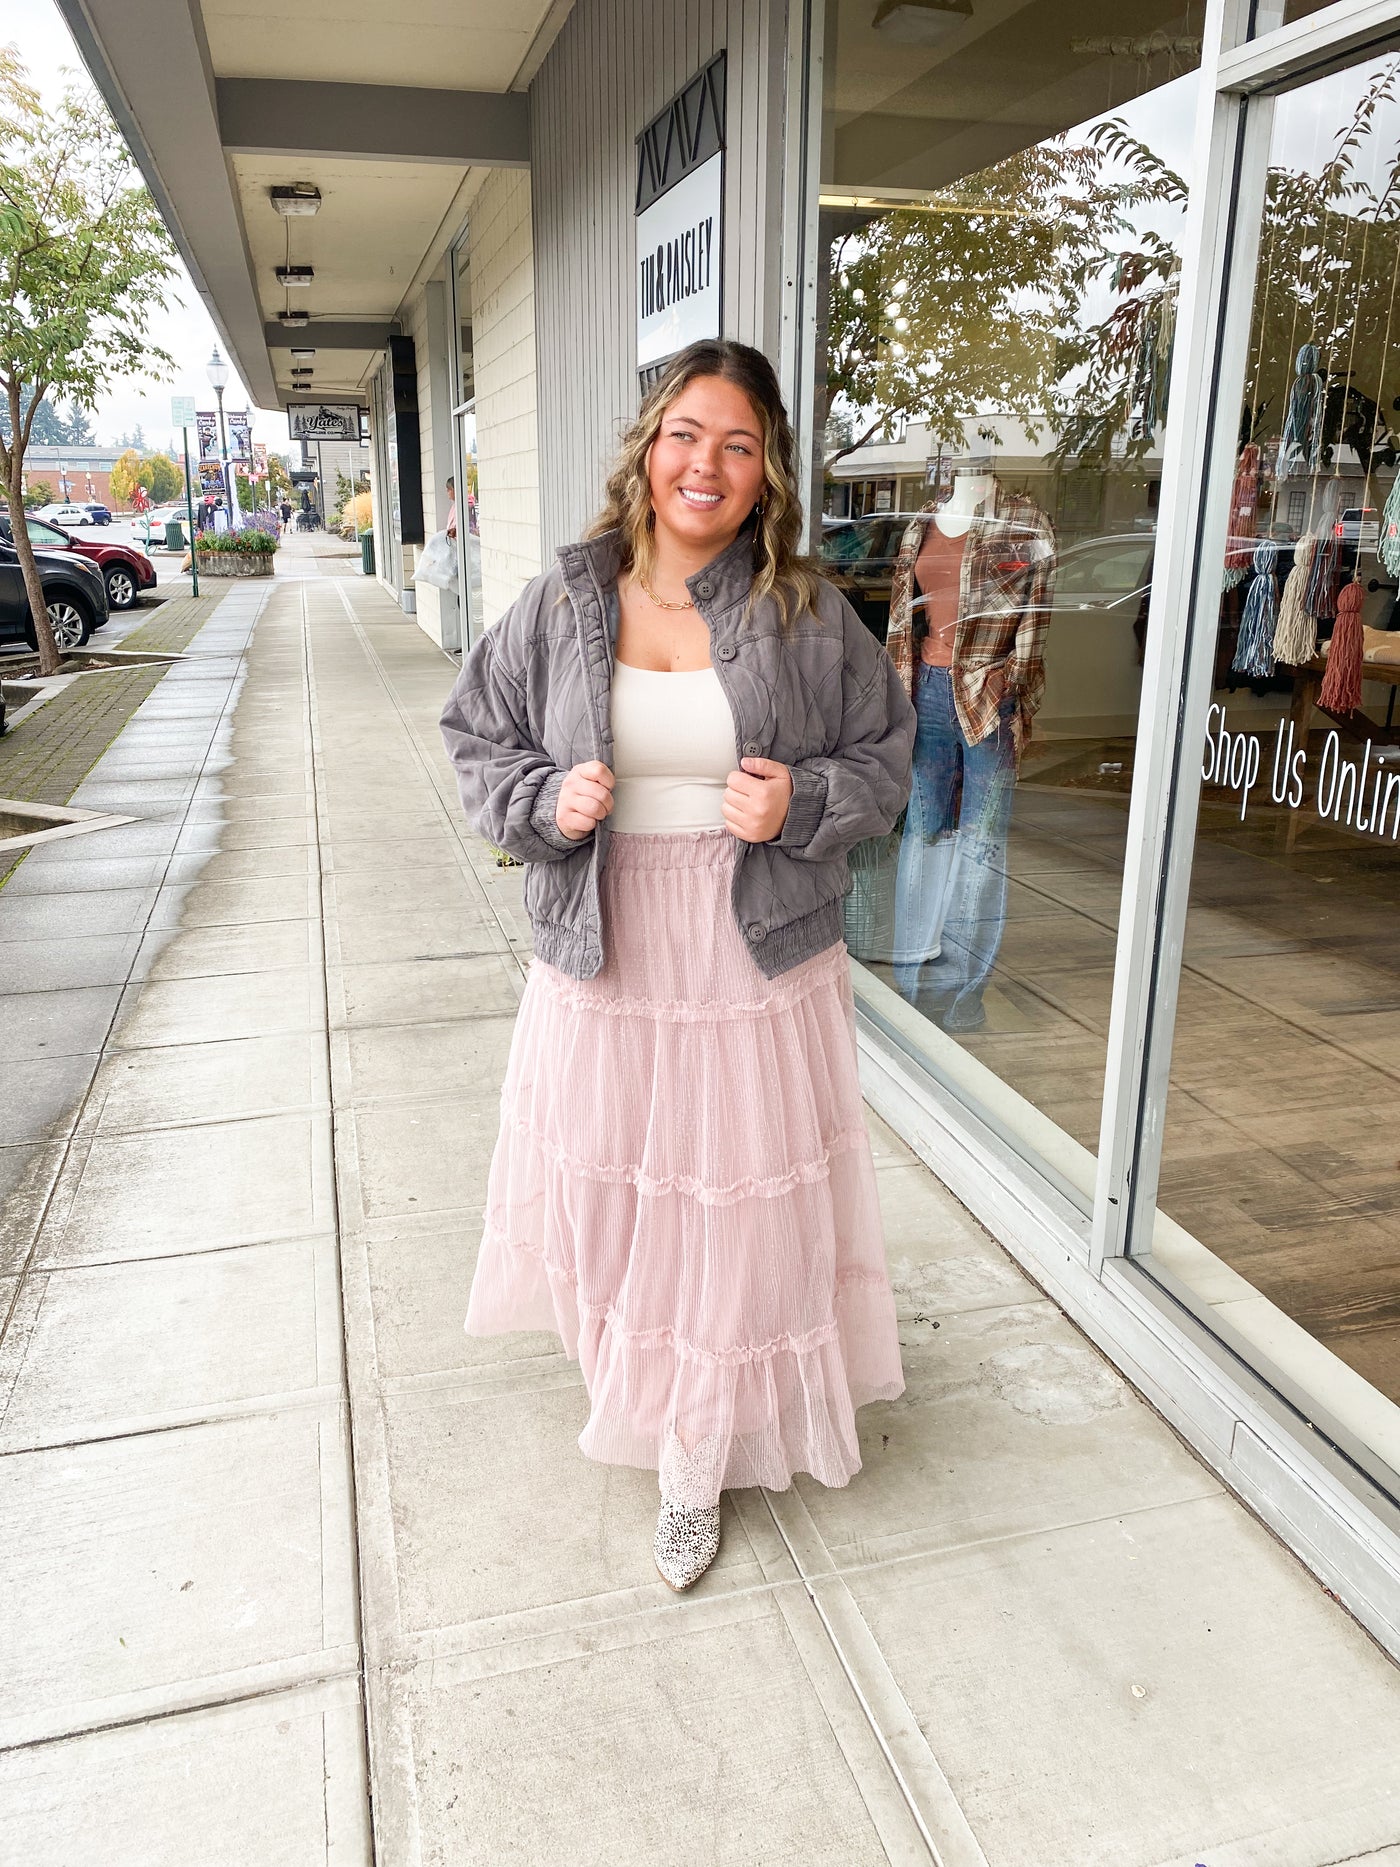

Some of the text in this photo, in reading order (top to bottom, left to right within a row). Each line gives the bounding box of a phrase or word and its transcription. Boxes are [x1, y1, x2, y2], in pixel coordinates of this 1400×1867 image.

[306, 415, 343, 430] Yates
[1201, 703, 1260, 821] Shop
[1272, 717, 1307, 808] Us
